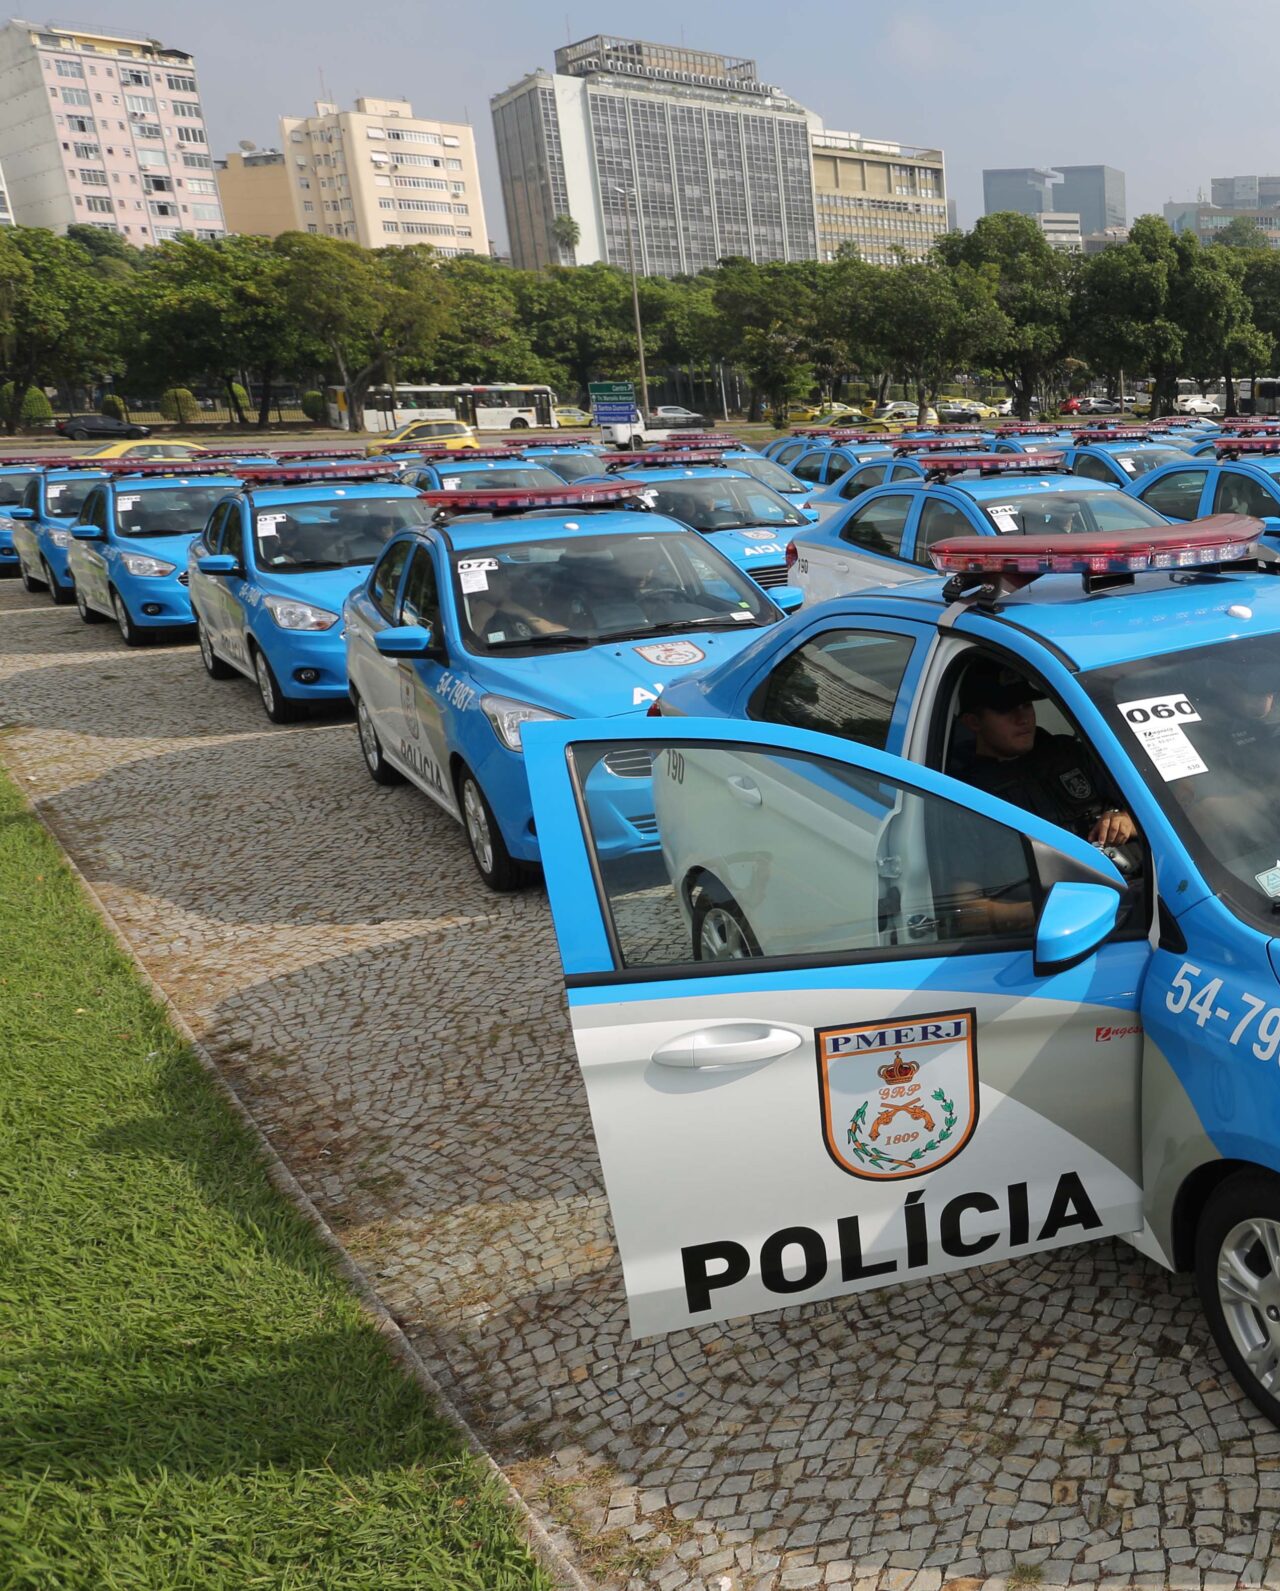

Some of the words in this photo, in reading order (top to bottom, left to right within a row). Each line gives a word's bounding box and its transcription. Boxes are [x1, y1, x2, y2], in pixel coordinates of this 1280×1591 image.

[459, 560, 498, 570] 078
[436, 671, 476, 712] 54-7987
[1126, 700, 1197, 723] 060
[666, 749, 685, 785] 190
[831, 1020, 965, 1053] PMERJ
[885, 1131, 920, 1146] 1809
[681, 1171, 1104, 1314] POLÍCIA
